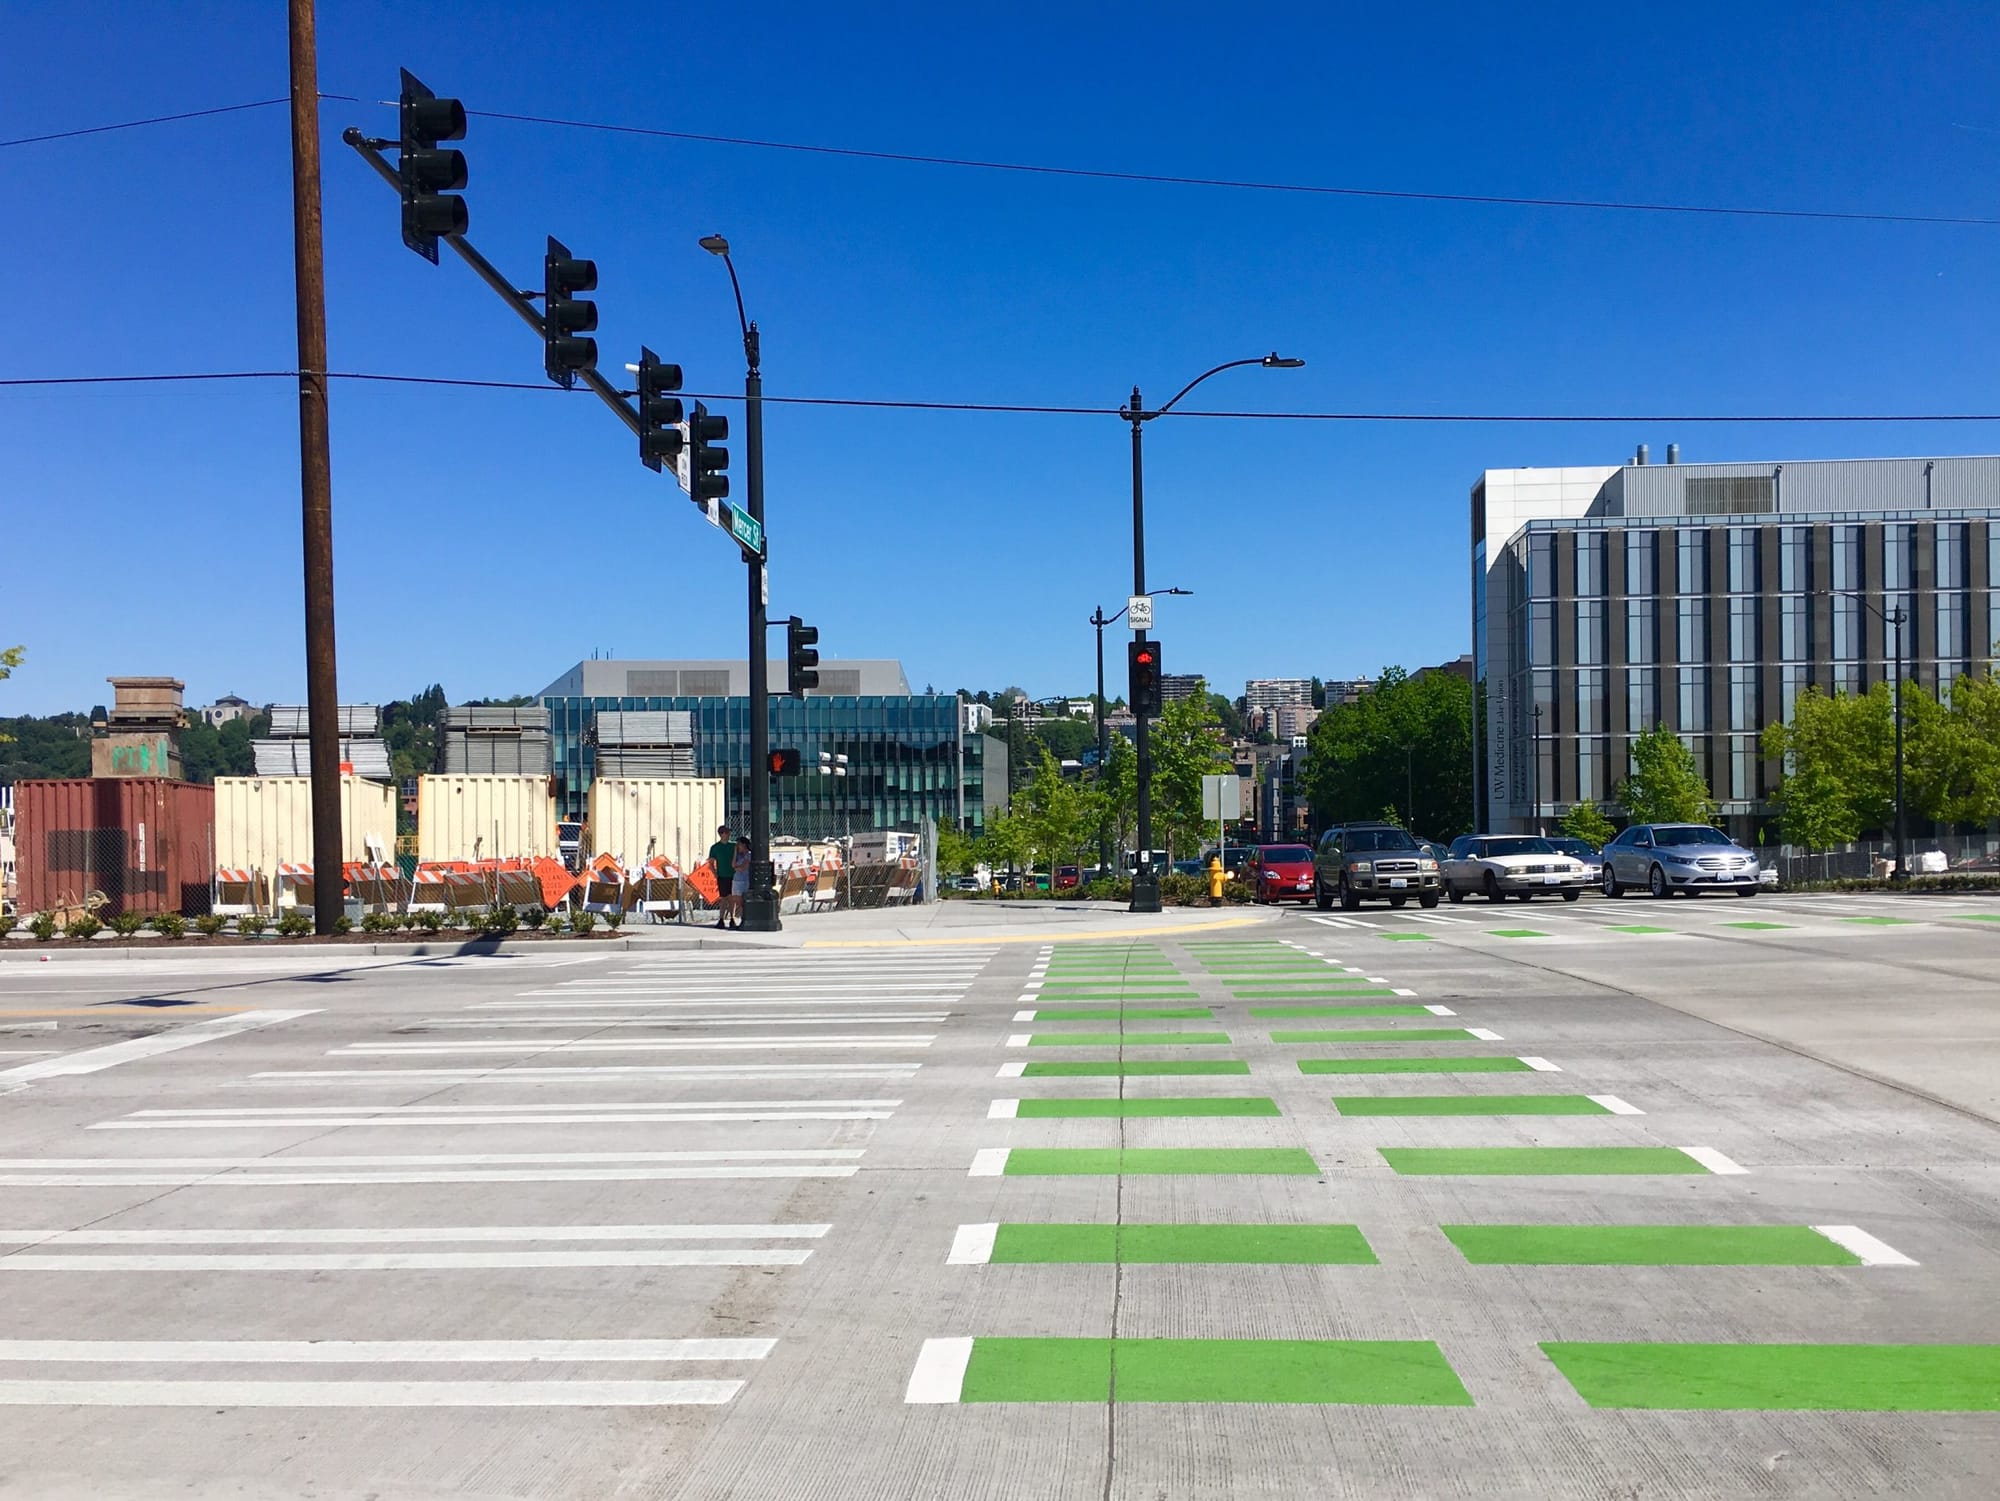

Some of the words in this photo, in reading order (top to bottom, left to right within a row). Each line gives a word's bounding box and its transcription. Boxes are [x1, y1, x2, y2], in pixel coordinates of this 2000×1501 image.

[734, 508, 752, 541] Mercer
[753, 524, 759, 547] St
[1494, 726, 1505, 776] Medicine
[1494, 780, 1505, 800] UW
